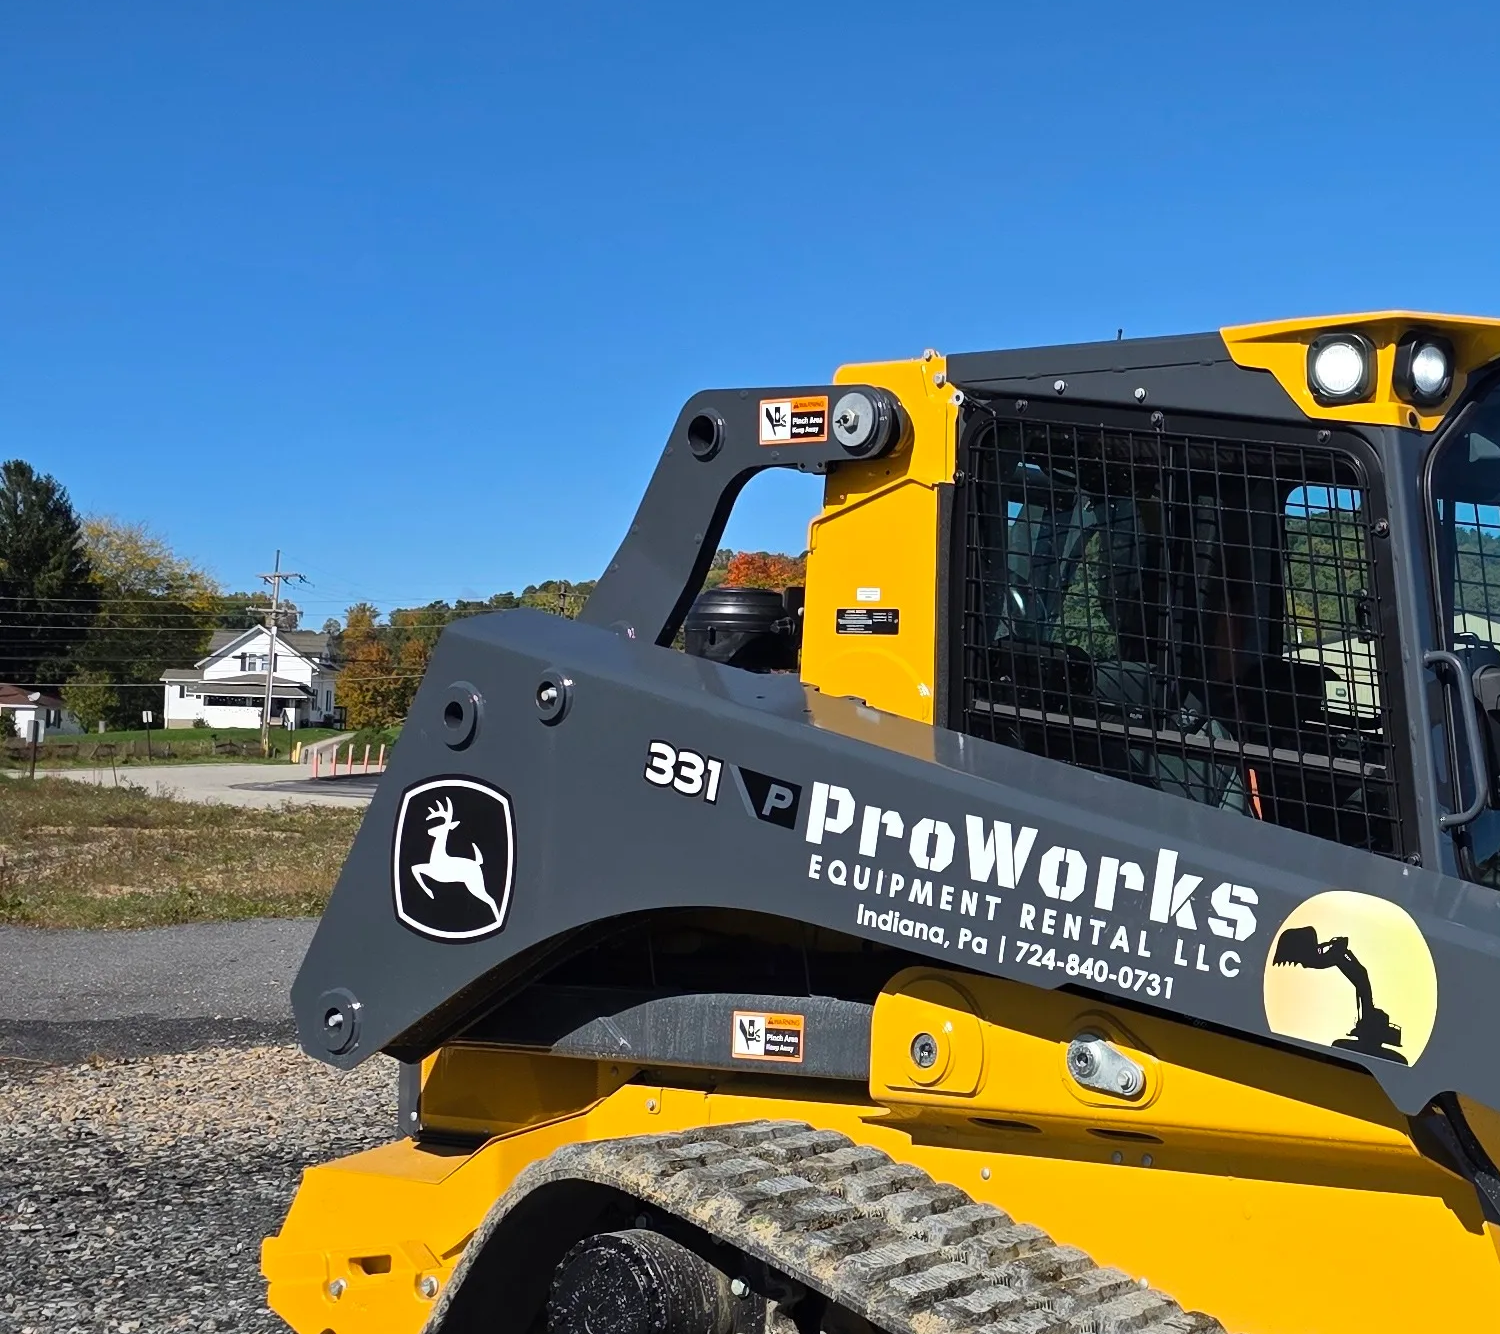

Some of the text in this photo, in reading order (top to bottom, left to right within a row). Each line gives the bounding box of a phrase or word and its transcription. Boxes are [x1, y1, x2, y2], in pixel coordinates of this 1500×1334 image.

[644, 740, 794, 816] 331 P
[805, 780, 1259, 942] ProWorks
[808, 853, 1242, 978] EQUIPMENT RENTAL LLC
[856, 903, 950, 948] Indiana,
[957, 927, 988, 955] Pa
[1015, 940, 1174, 1000] 724-840-0731
[766, 1033, 799, 1043] Pinch Area
